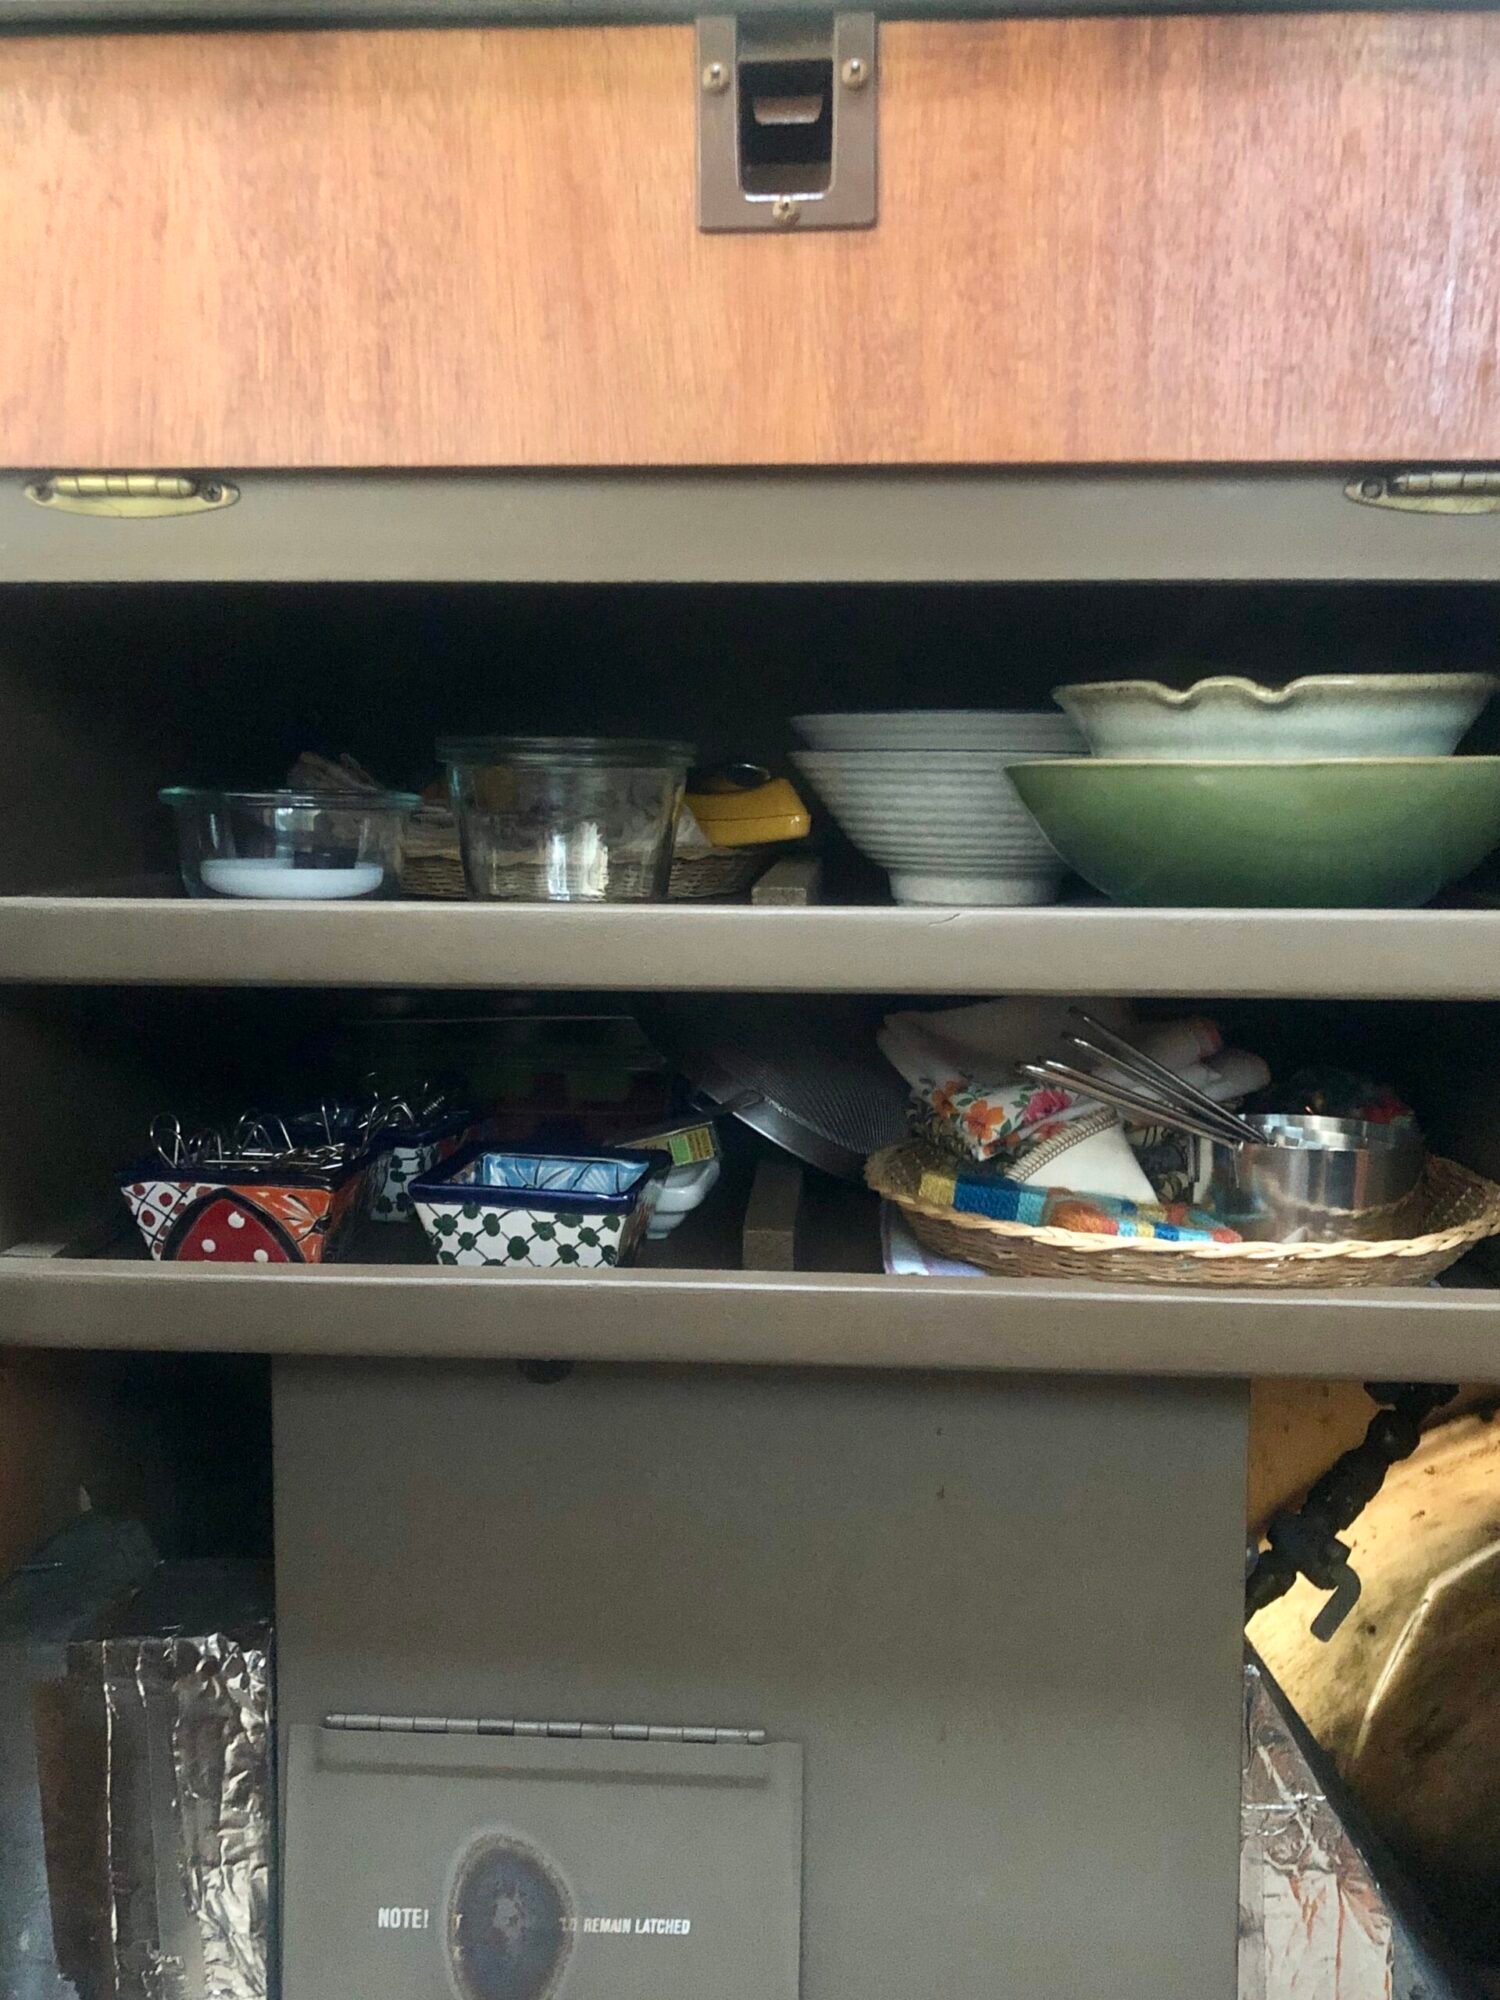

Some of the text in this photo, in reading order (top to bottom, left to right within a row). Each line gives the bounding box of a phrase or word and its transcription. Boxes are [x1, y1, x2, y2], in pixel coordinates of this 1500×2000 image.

[378, 1907, 429, 1929] NOTE!
[584, 1918, 632, 1934] REMAIN
[635, 1918, 691, 1935] LATCHED
